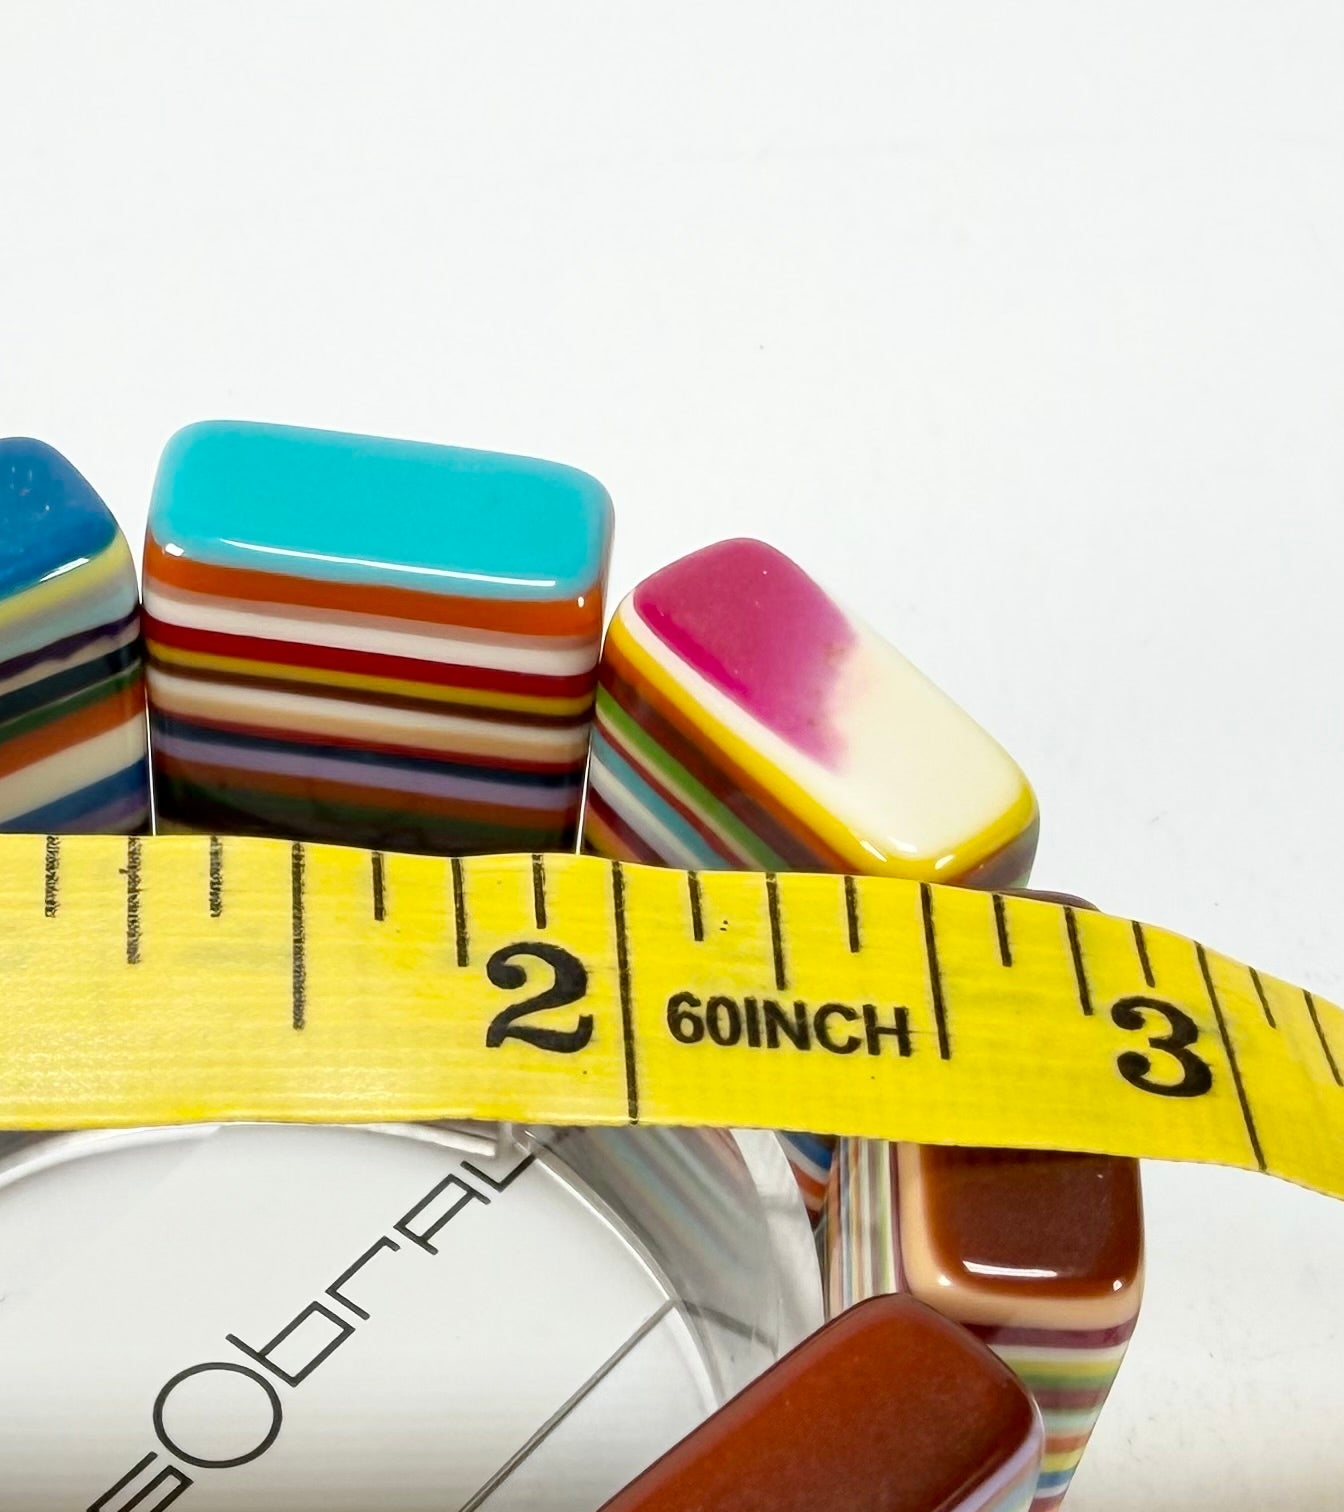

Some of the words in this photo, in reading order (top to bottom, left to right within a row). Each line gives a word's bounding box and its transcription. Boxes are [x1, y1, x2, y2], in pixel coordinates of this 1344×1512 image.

[485, 941, 593, 1054] 2
[667, 991, 911, 1057] 60INCH
[1111, 997, 1213, 1098] 3
